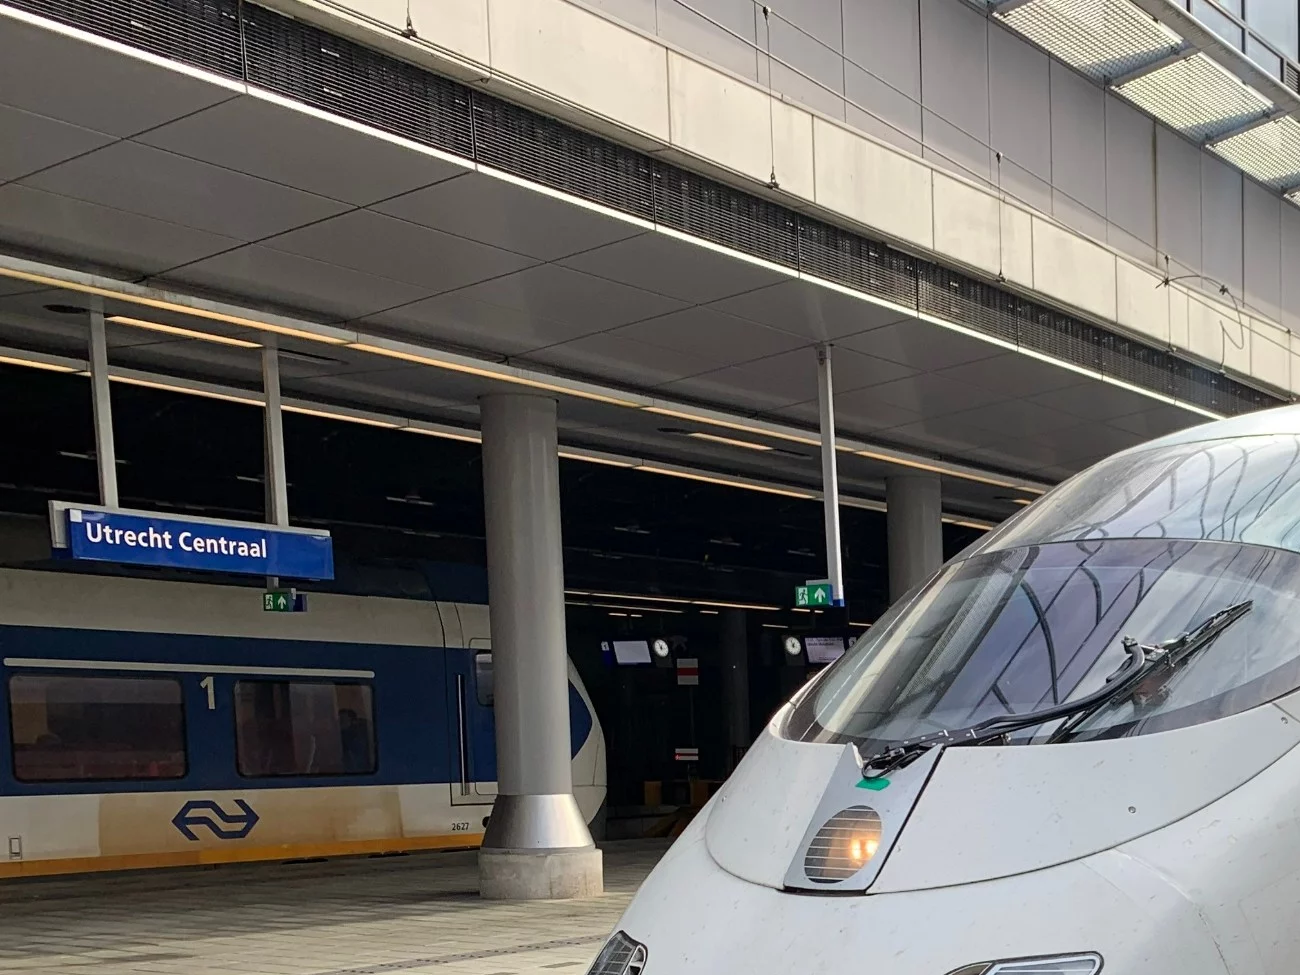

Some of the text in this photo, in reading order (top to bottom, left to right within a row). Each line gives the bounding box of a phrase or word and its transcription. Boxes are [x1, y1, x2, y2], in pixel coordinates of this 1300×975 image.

[86, 522, 267, 558] Utrecht Centraal
[200, 676, 215, 709] 1
[452, 822, 469, 831] 2627
